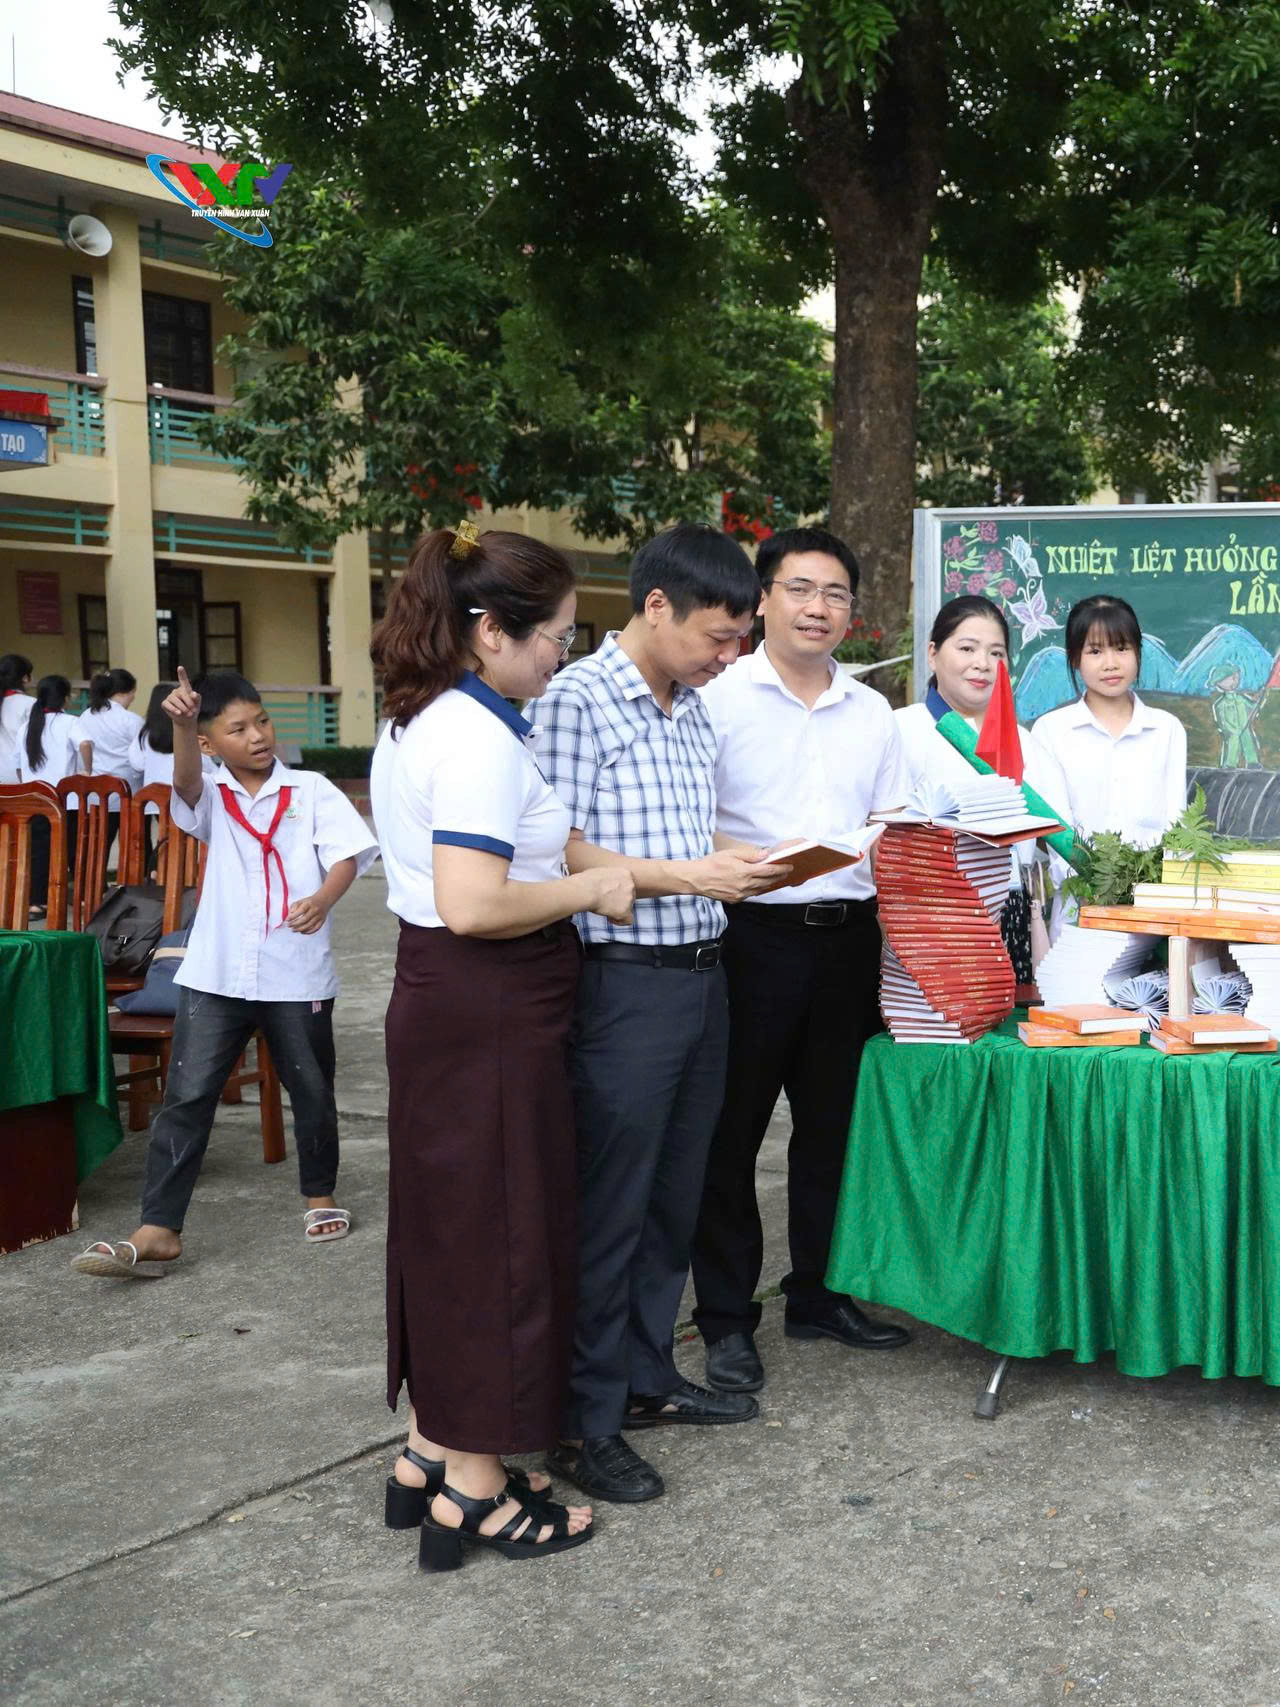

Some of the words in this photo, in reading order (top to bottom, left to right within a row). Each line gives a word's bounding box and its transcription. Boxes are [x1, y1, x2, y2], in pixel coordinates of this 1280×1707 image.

[0, 433, 25, 456] TẠO
[1045, 539, 1117, 580] NHIỆT
[1131, 540, 1176, 578] LIỆT
[1184, 533, 1278, 573] HƯỞNG
